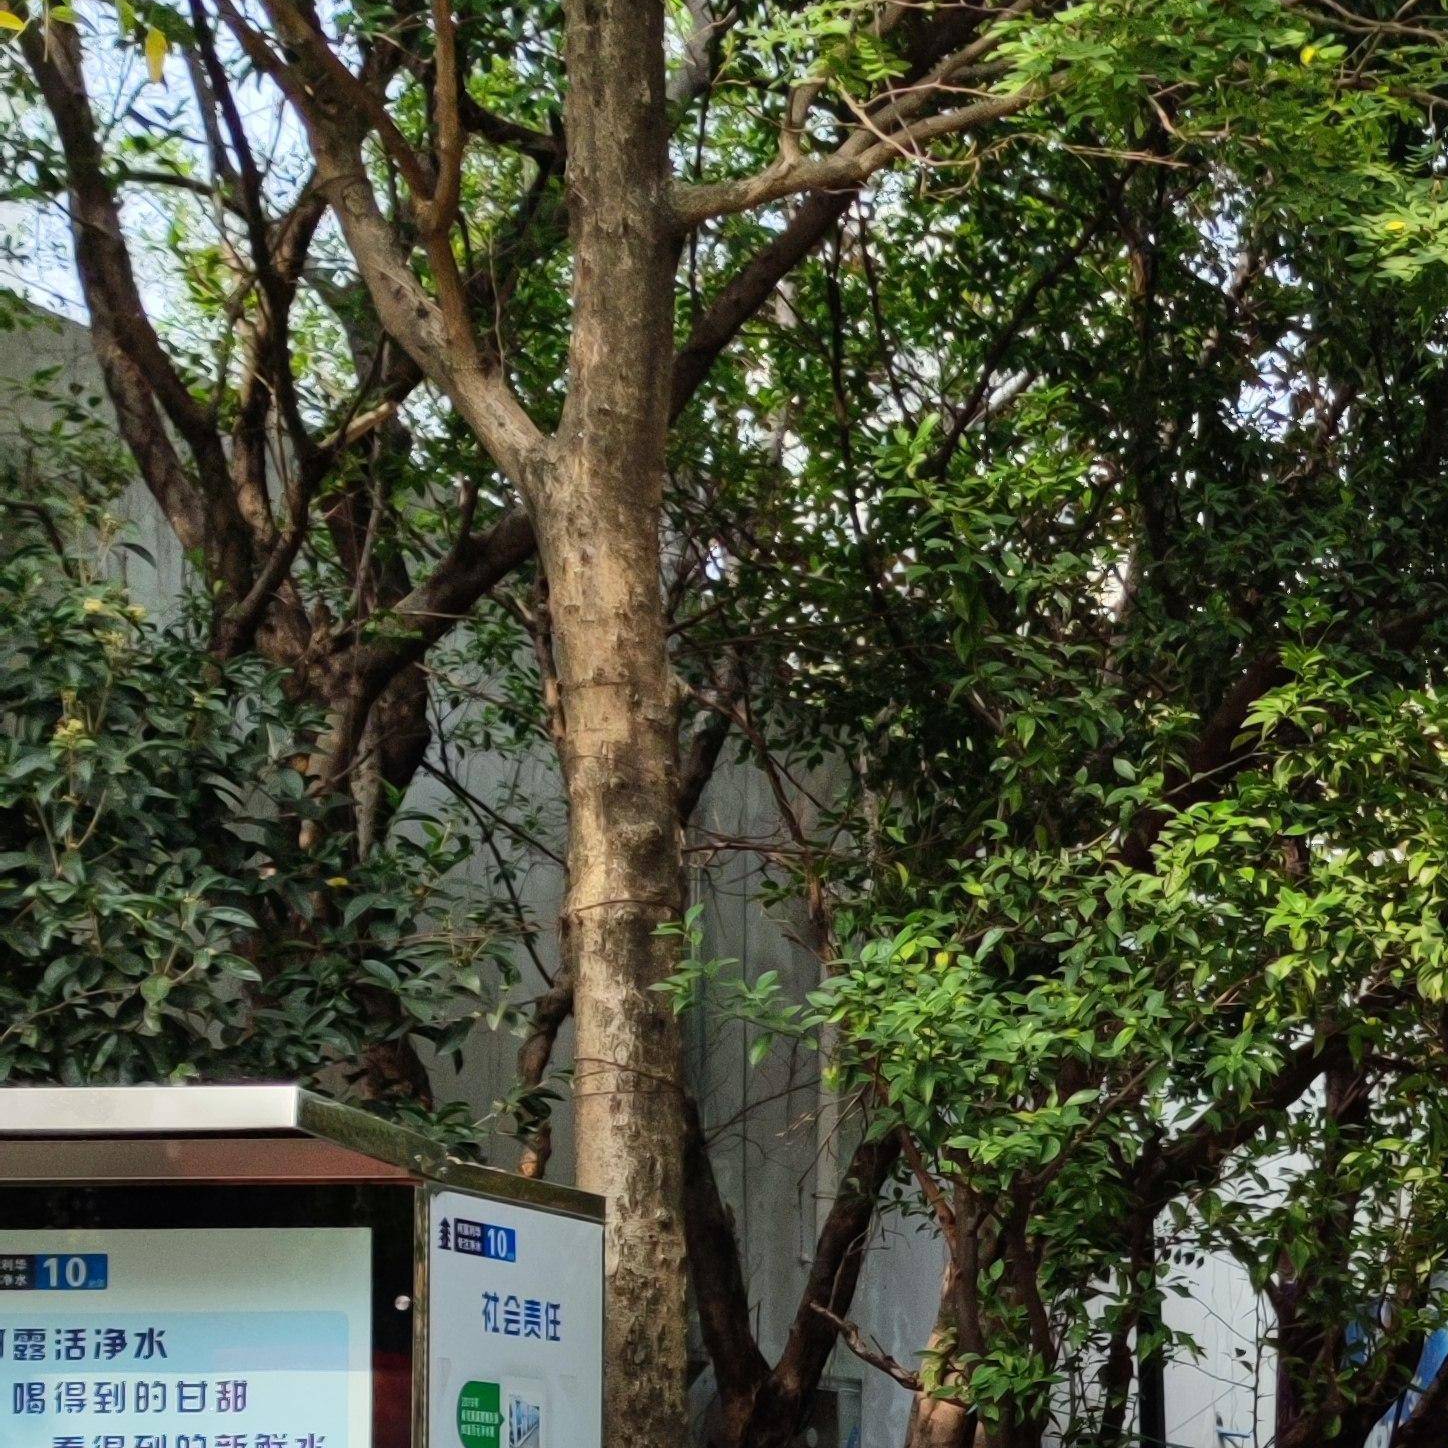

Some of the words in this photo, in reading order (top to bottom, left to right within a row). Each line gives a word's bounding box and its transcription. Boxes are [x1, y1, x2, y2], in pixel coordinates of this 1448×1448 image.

[43, 1257, 87, 1287] 10
[481, 1291, 561, 1341] 社会责任
[0, 1327, 168, 1360] 露活净水
[12, 1380, 248, 1414] 喝得到的甘甜
